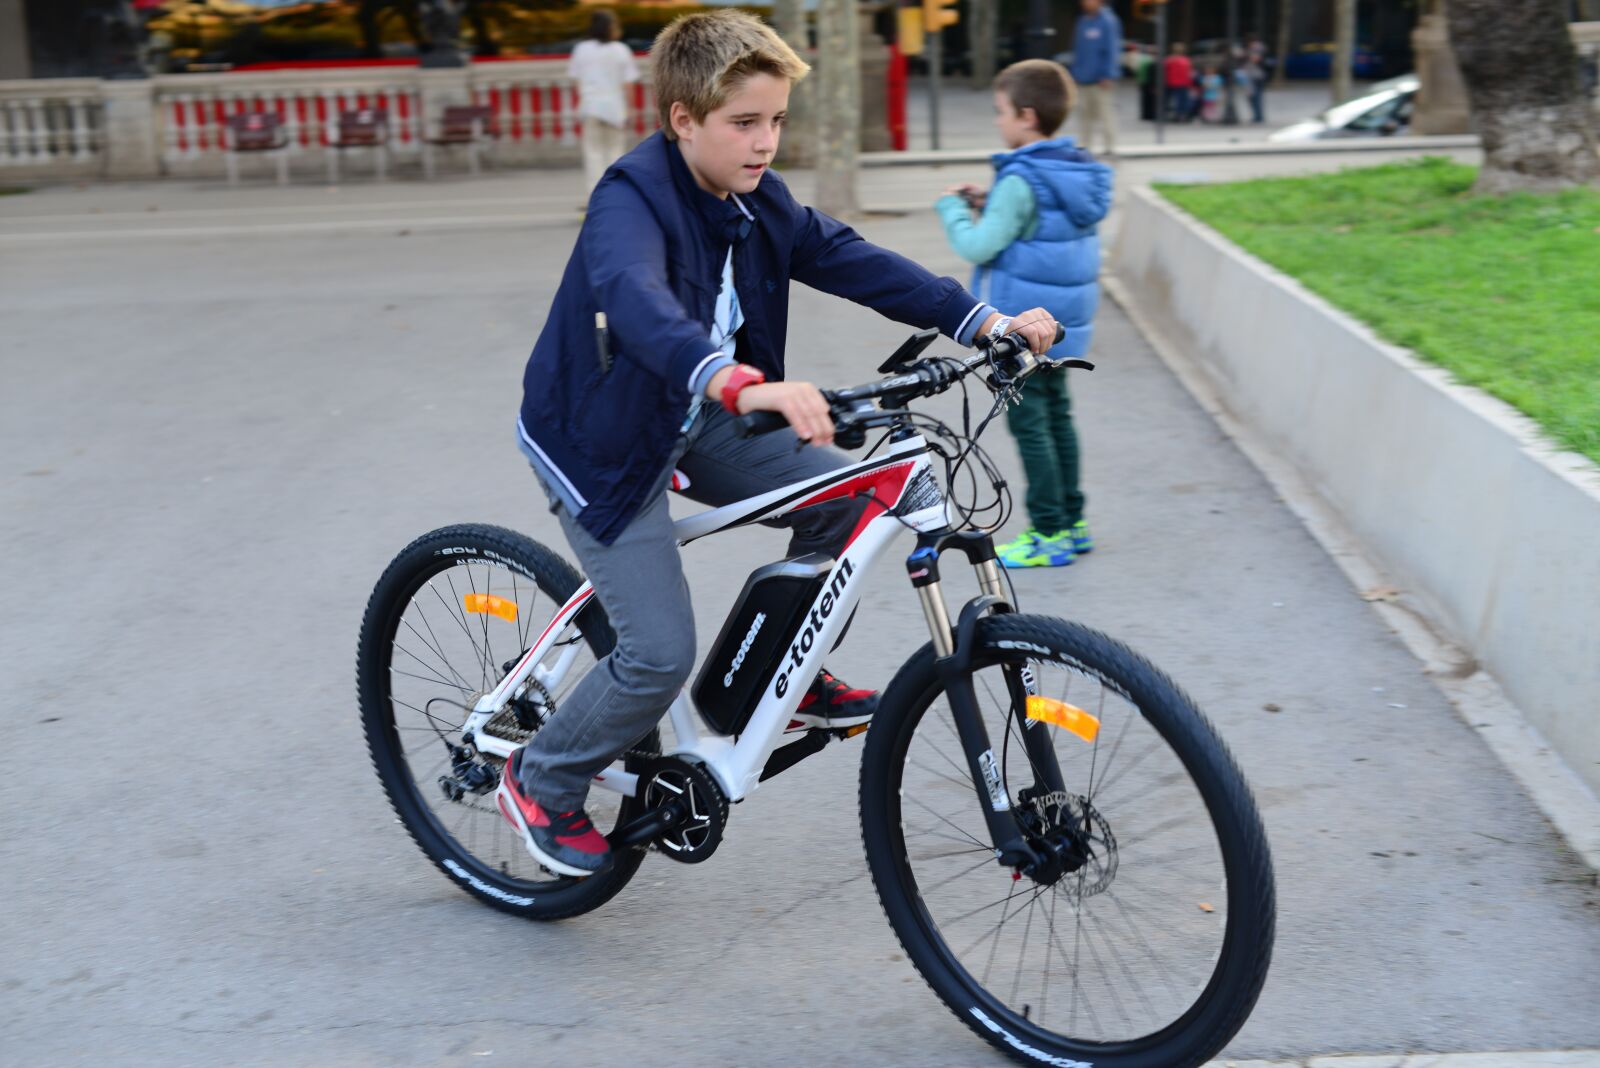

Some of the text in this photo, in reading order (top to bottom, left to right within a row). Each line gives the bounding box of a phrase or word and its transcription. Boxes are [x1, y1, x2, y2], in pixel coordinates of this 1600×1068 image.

[441, 546, 478, 555] ROB
[723, 612, 767, 688] e-totem
[774, 557, 853, 699] e-totem
